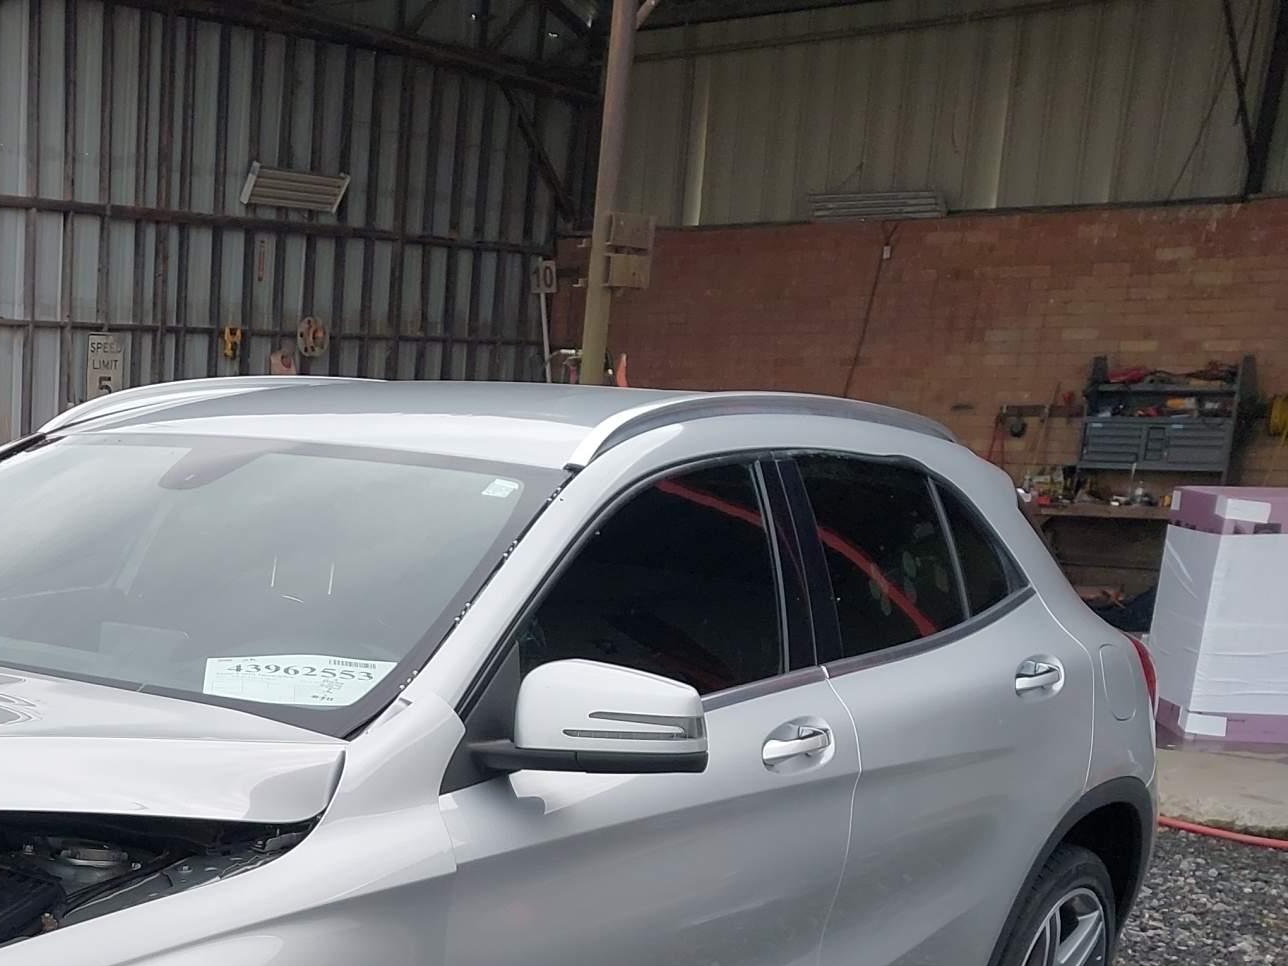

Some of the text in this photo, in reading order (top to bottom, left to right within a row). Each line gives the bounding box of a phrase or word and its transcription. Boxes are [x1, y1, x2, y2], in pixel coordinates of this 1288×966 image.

[90, 342, 122, 353] SPEED
[92, 359, 119, 370] LIMIT
[98, 375, 113, 393] 5
[226, 663, 374, 682] 43962553
